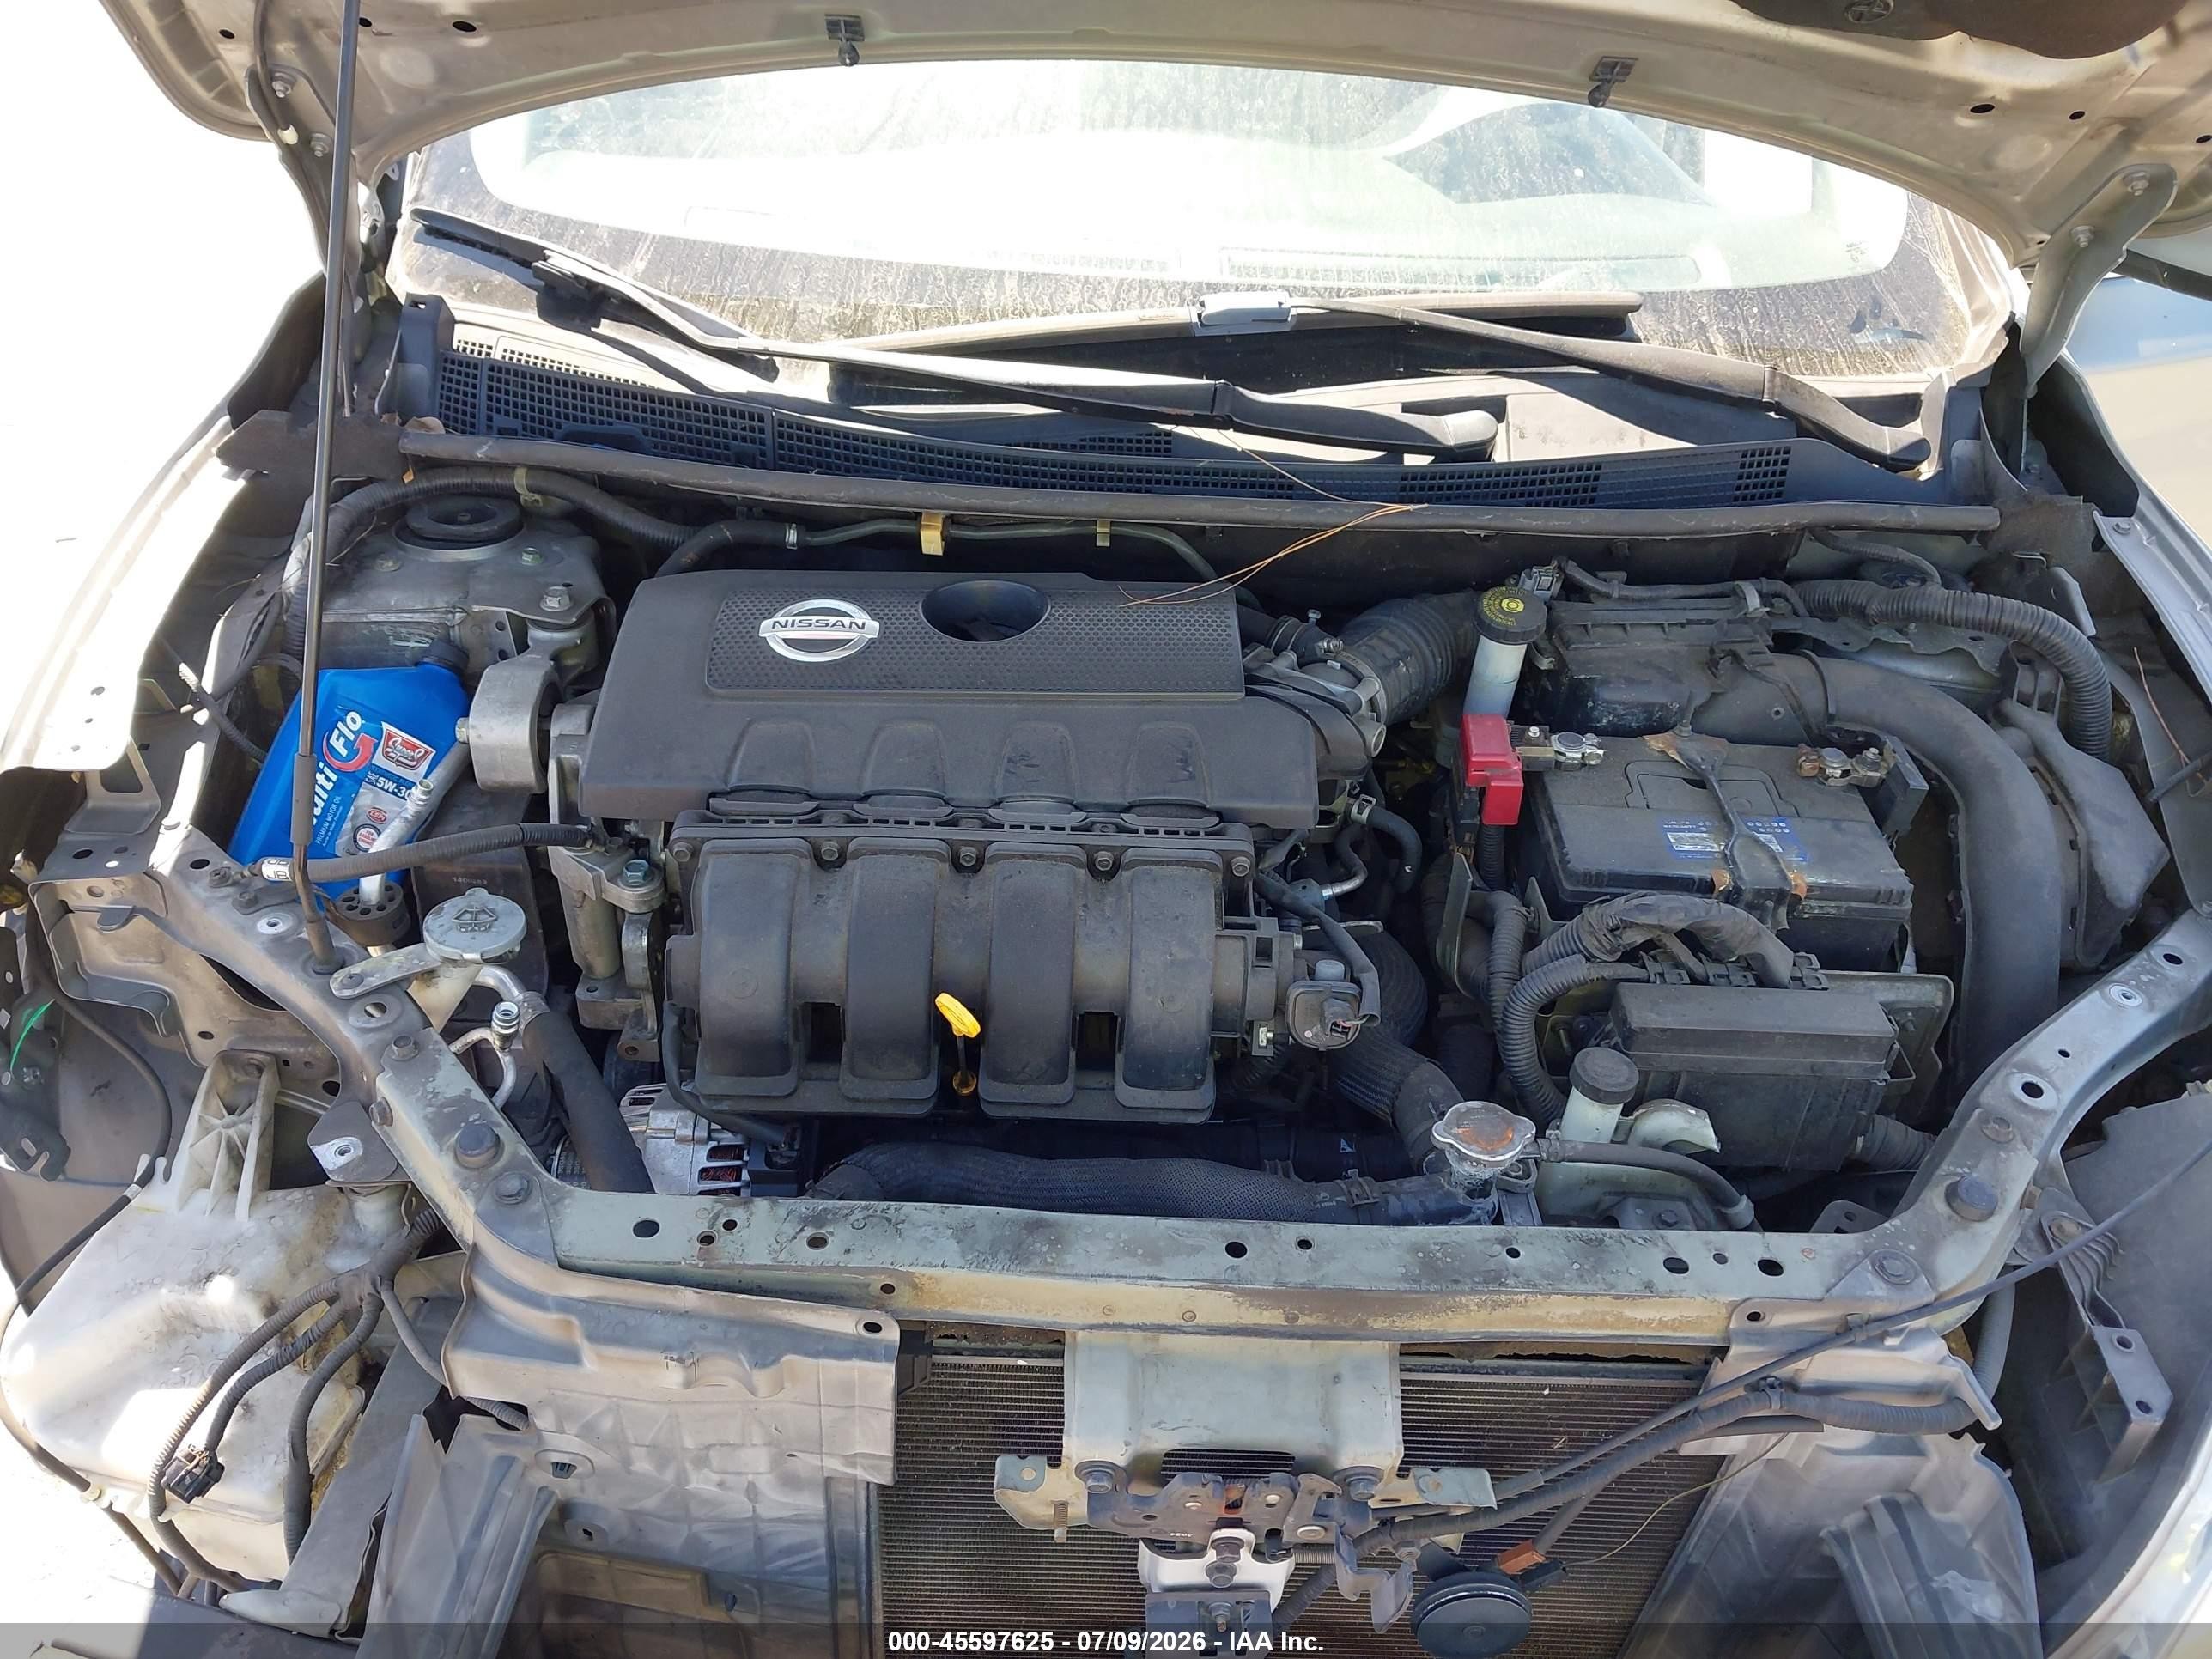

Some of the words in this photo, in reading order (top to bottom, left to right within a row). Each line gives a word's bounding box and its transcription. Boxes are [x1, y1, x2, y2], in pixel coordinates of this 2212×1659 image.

[771, 618, 866, 630] NISSAN
[313, 762, 338, 825] ulti
[330, 711, 362, 757] Flo
[315, 821, 329, 844] PREMIUM
[326, 803, 337, 822] MOTOR
